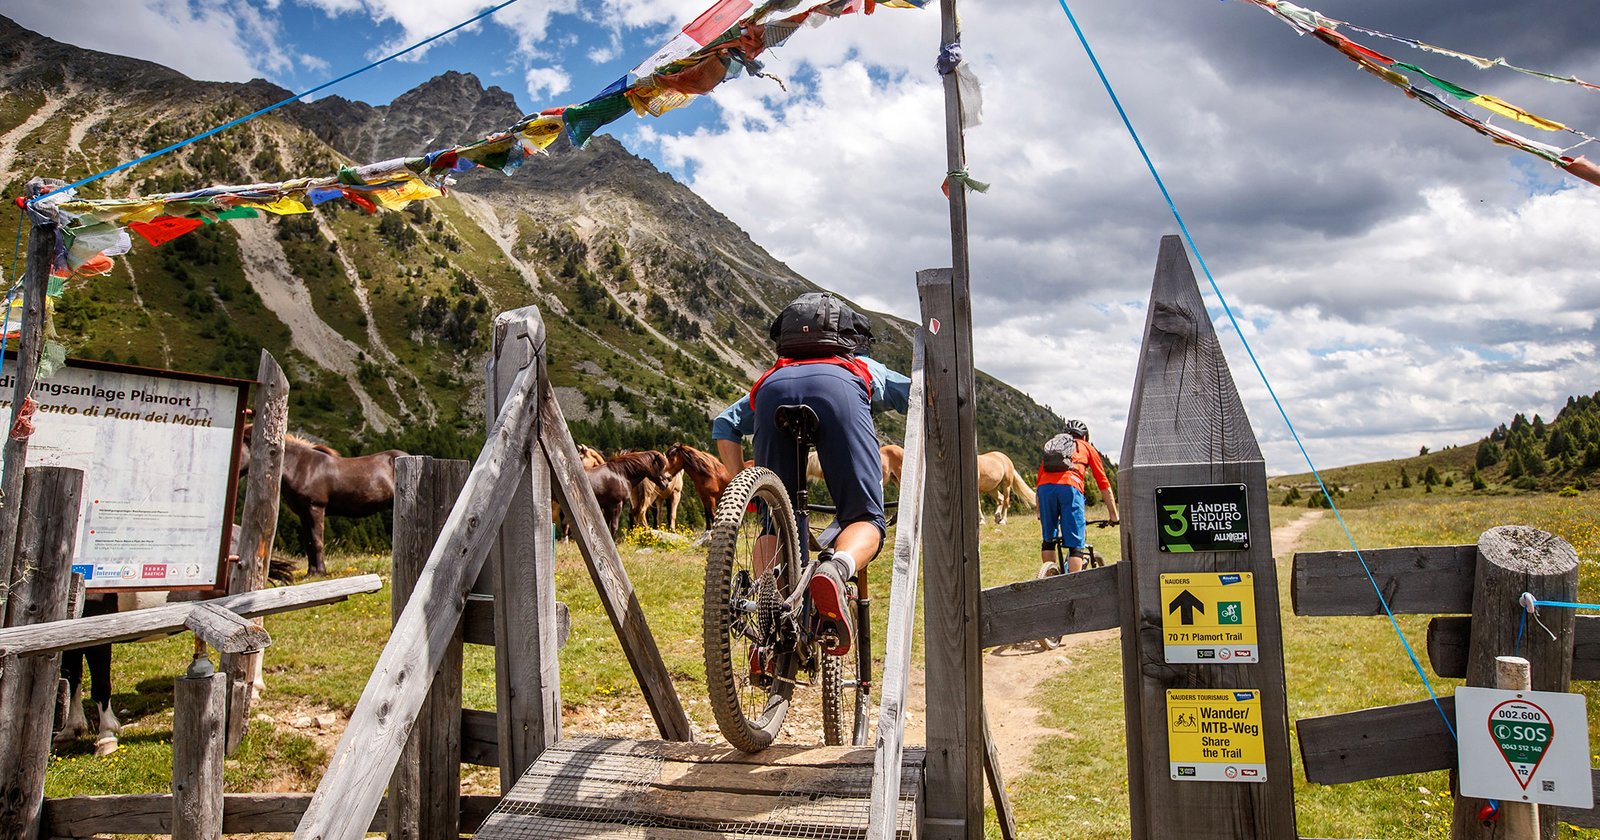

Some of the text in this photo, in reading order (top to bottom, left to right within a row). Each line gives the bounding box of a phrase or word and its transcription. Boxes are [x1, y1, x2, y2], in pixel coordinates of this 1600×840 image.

[0, 375, 192, 407] dingsanlage Plamort
[83, 405, 100, 418] di
[104, 407, 141, 421] Pian
[145, 411, 169, 424] dei
[173, 414, 212, 428] Morti
[1190, 502, 1238, 513] LÄNDER
[1163, 505, 1188, 537] 3
[1191, 511, 1242, 522] ENDURO
[1192, 520, 1232, 531] TRAILS
[1168, 632, 1243, 641] 70 71 Plamort Trail
[1200, 707, 1250, 720] Wander/
[1499, 710, 1541, 721] 002.600
[1201, 721, 1259, 737] MTB-Weg
[1513, 726, 1547, 742] SOS
[1201, 736, 1231, 747] Share
[1501, 743, 1517, 751] 0043
[1202, 748, 1243, 759] the Trail
